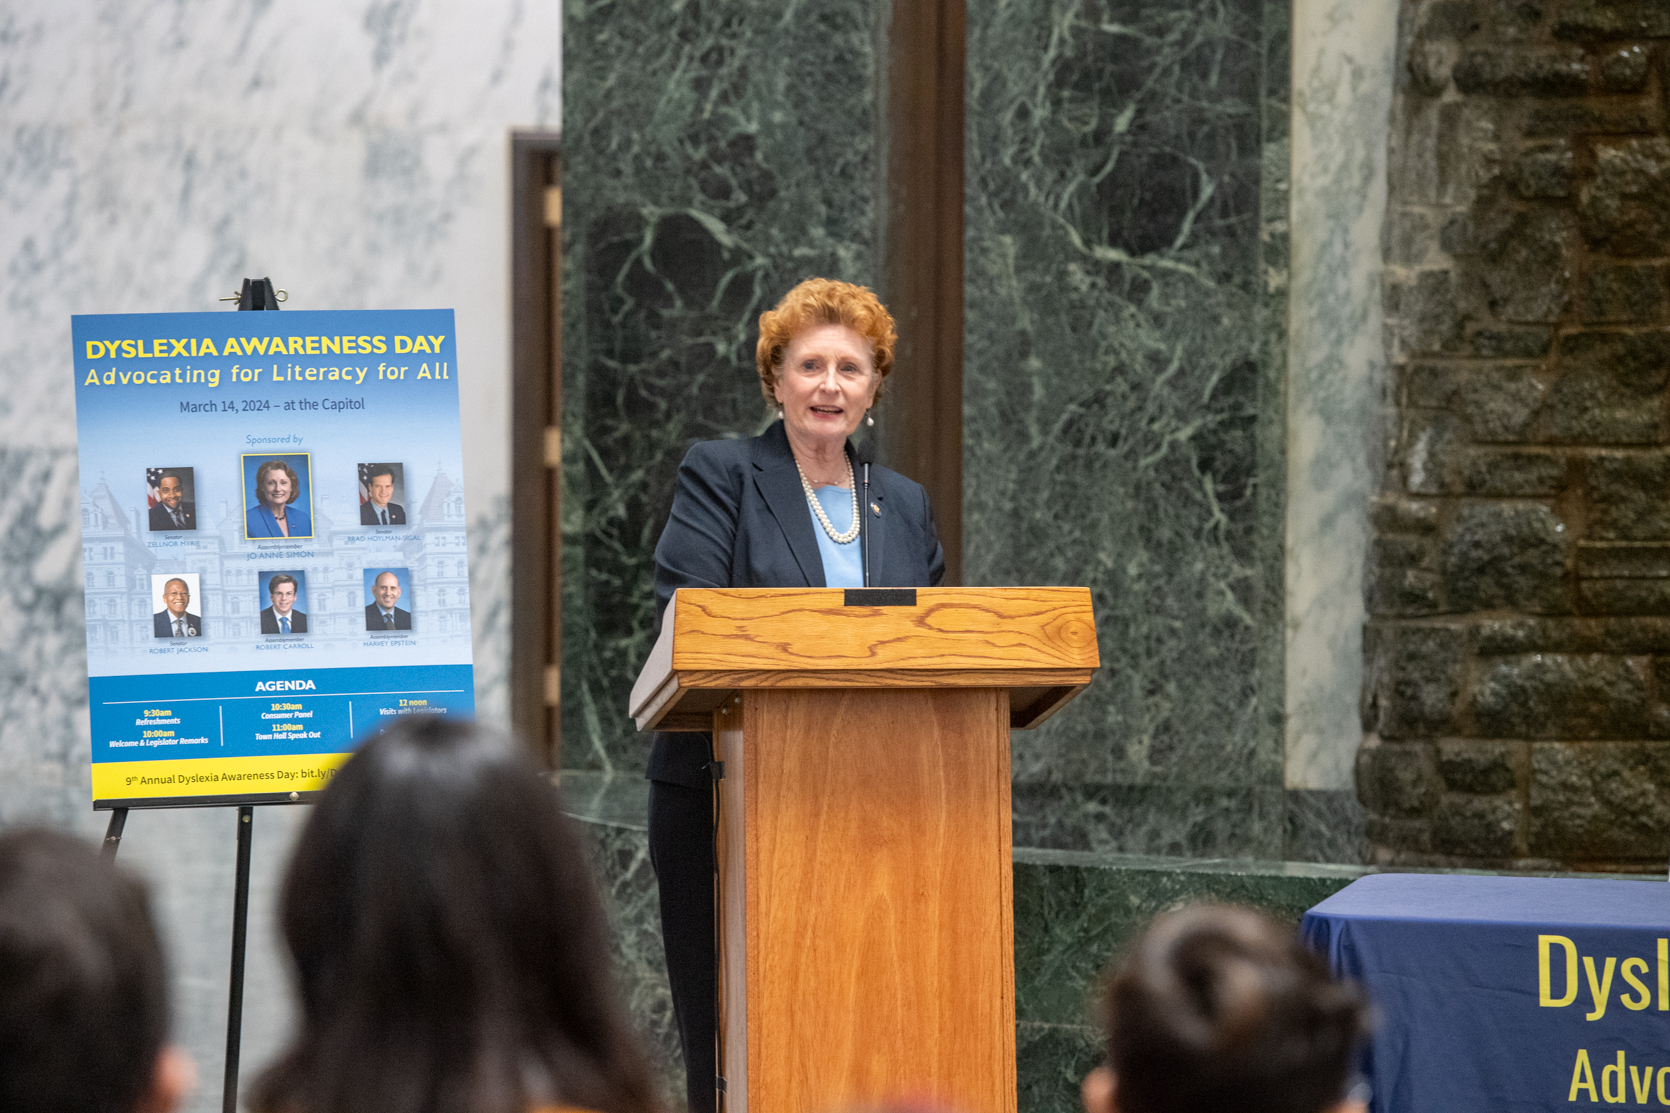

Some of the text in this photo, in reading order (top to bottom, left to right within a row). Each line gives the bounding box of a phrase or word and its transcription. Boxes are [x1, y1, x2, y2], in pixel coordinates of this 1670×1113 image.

[86, 335, 446, 359] DYSLEXIA AWARENESS DAY
[84, 362, 449, 388] Advocating for Literacy for All
[180, 400, 218, 413] March
[221, 400, 239, 414] 14,
[241, 399, 271, 412] 2024
[283, 400, 297, 411] at
[299, 398, 319, 411] the
[321, 397, 365, 413] Capitol
[245, 434, 304, 447] Sponsored by
[247, 550, 315, 561] JO ANNE SIMON
[149, 646, 209, 655] ROBERT JACKSON
[255, 680, 316, 692] AGENDA
[271, 703, 303, 711] 10:30am
[380, 707, 397, 715] Visits
[398, 707, 412, 715] with
[143, 709, 172, 717] 9:30am
[135, 717, 181, 726] Refreshments
[272, 724, 304, 732] 11:00am
[142, 730, 175, 738] 10:00am
[273, 732, 287, 740] Hall
[288, 732, 308, 740] Speak
[109, 737, 209, 748] Welcome & Legislator Remarks
[140, 775, 176, 785] Annual
[178, 773, 219, 786] Dyslexia
[221, 772, 275, 781] Awareness
[277, 771, 299, 781] Day:
[1538, 934, 1669, 1021] Dysl
